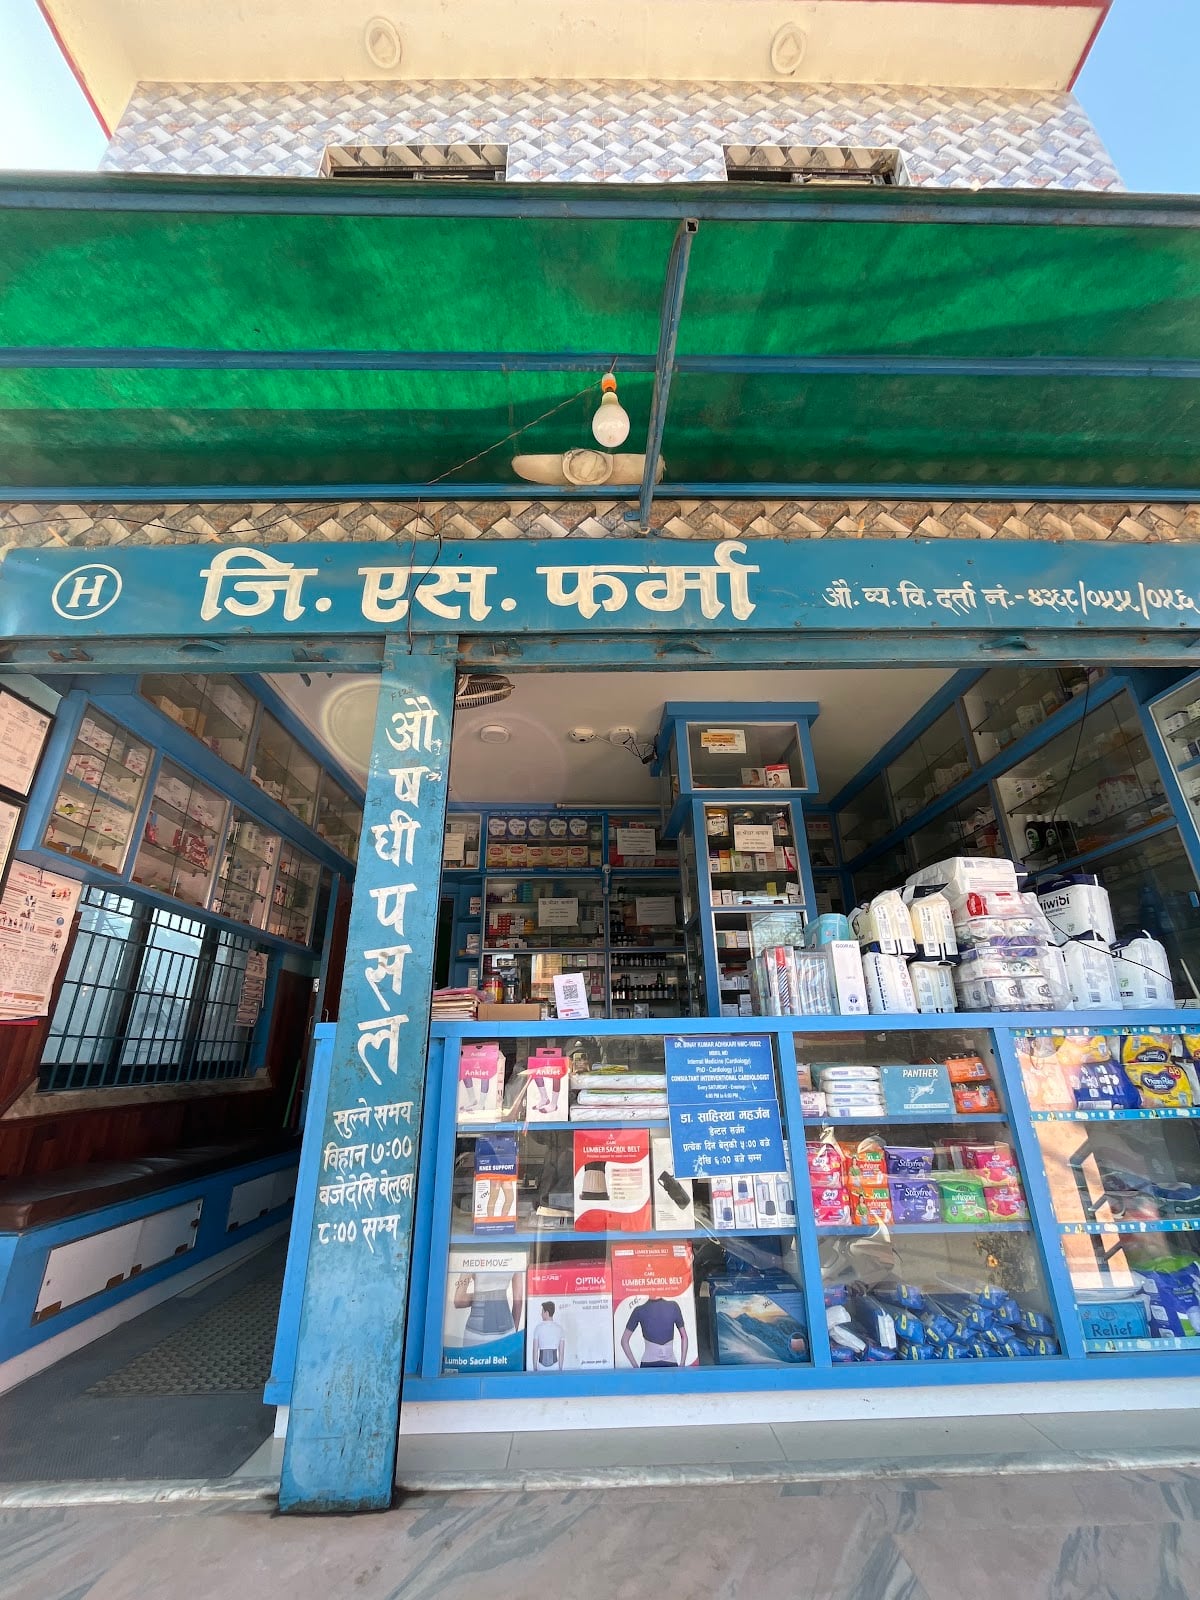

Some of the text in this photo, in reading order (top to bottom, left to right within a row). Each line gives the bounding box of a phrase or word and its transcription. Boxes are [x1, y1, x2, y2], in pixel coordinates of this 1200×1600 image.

[200, 540, 760, 623] जि. एस. फर्मा
[903, 1068, 939, 1078] PANTHER
[373, 1101, 414, 1131] समय
[627, 1145, 641, 1153] BELT
[898, 1158, 926, 1168] Stayfree
[904, 1186, 933, 1198] Stayfree
[951, 1194, 977, 1202] whisper
[361, 1214, 400, 1254] सम्म
[462, 1258, 509, 1267] MEDEMOVE
[575, 1277, 606, 1285] OPTIKA
[622, 1276, 683, 1286] LUMBER SACROL BELT
[1091, 1321, 1133, 1337] Relief
[444, 1356, 508, 1365] Lumbo Sacral Belt
